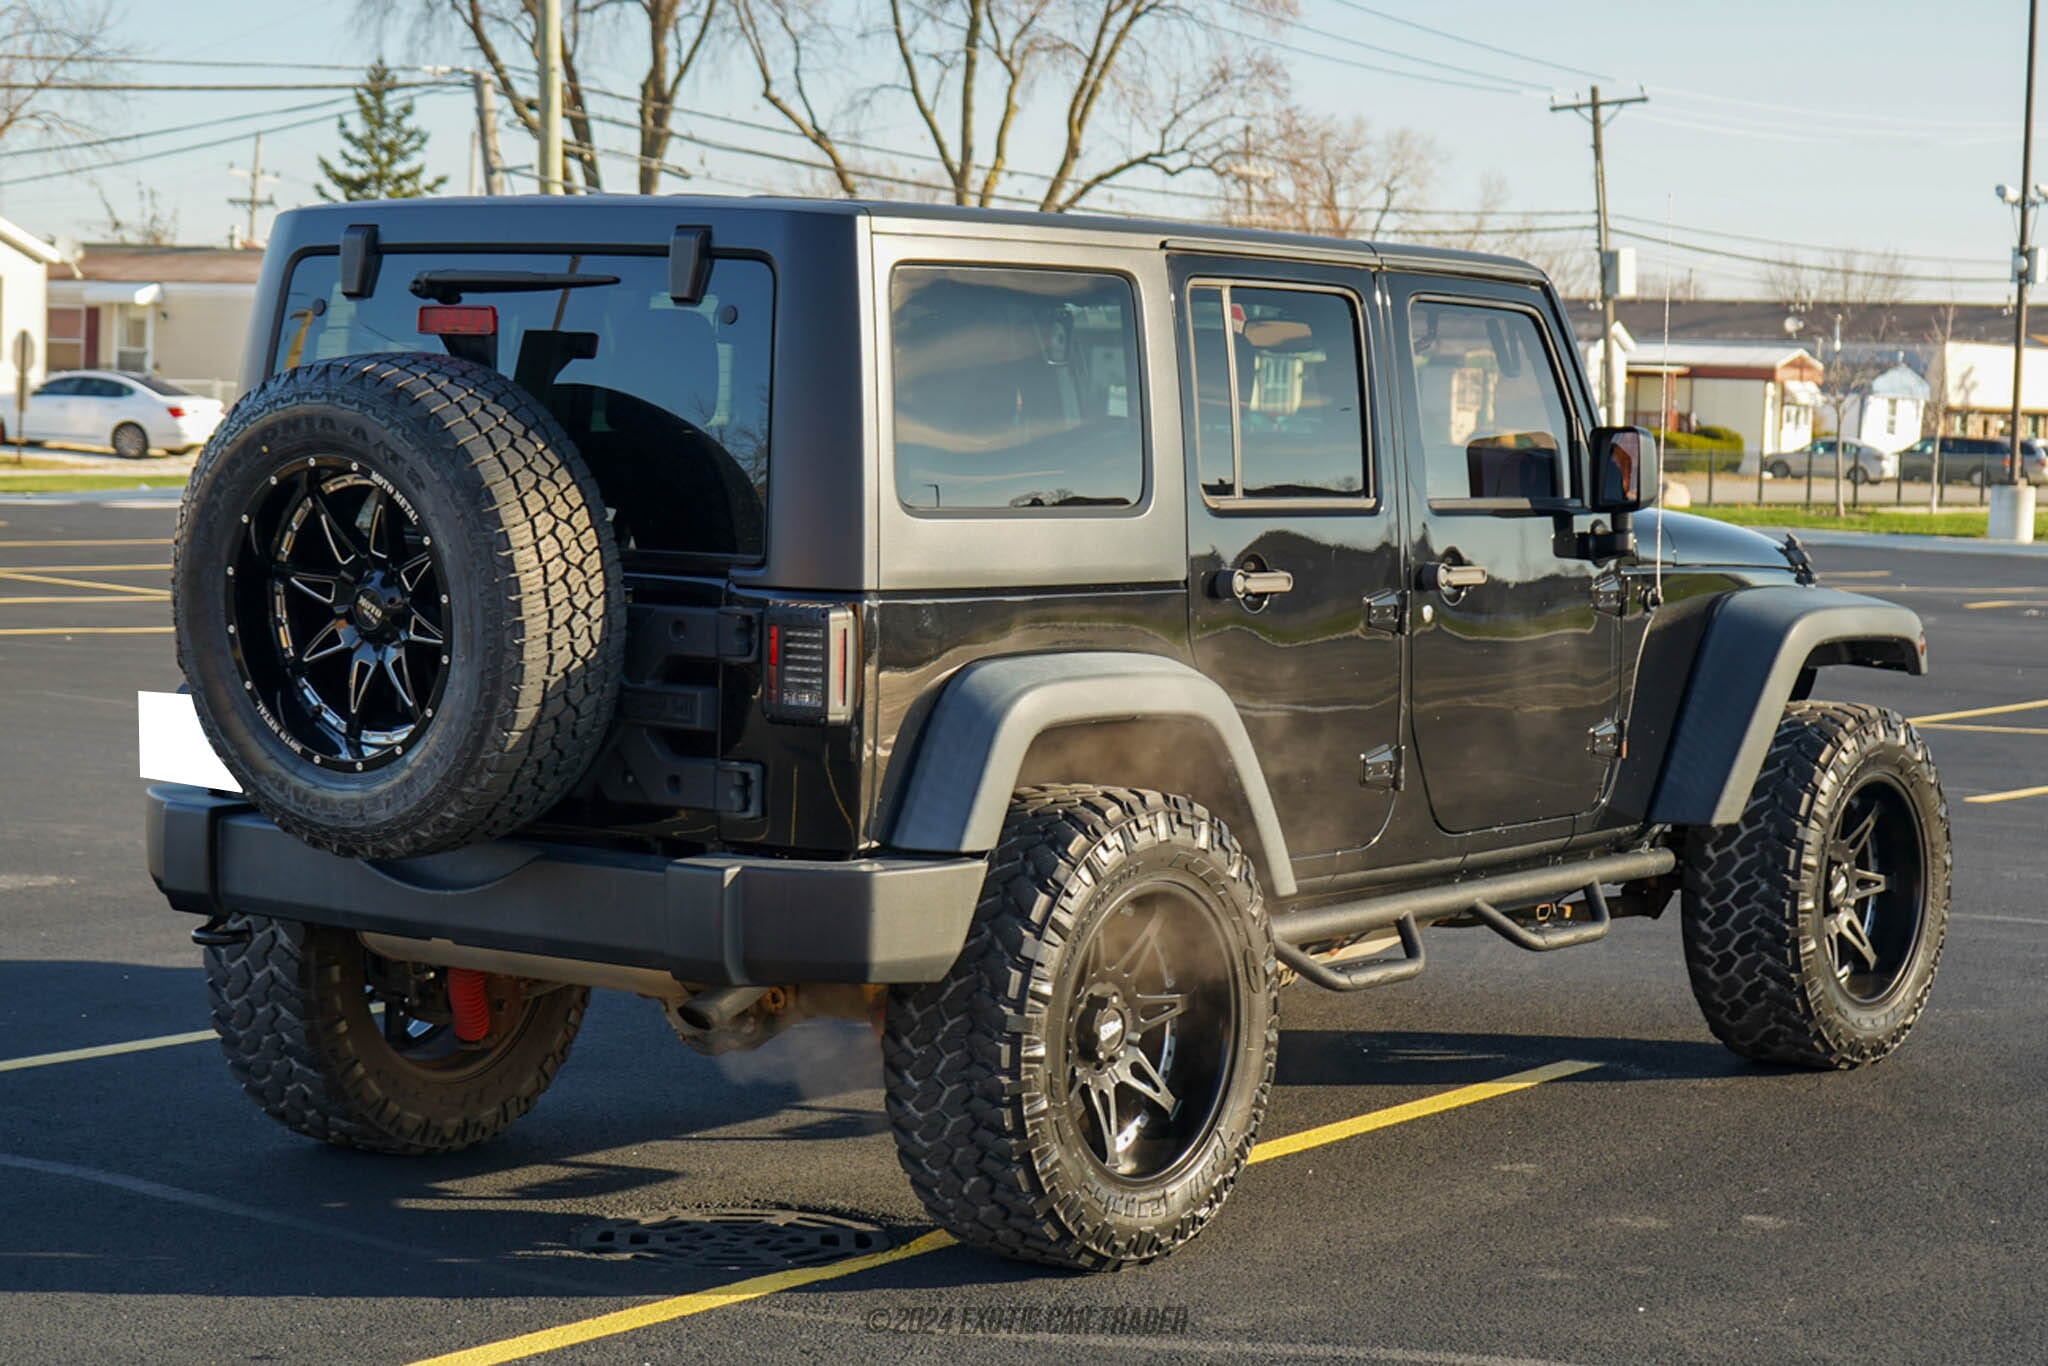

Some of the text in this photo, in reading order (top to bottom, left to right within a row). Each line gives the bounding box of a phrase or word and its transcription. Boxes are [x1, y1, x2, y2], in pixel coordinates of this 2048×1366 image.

[369, 469, 420, 527] MOTO METAL
[255, 699, 304, 755] MOTO METAL
